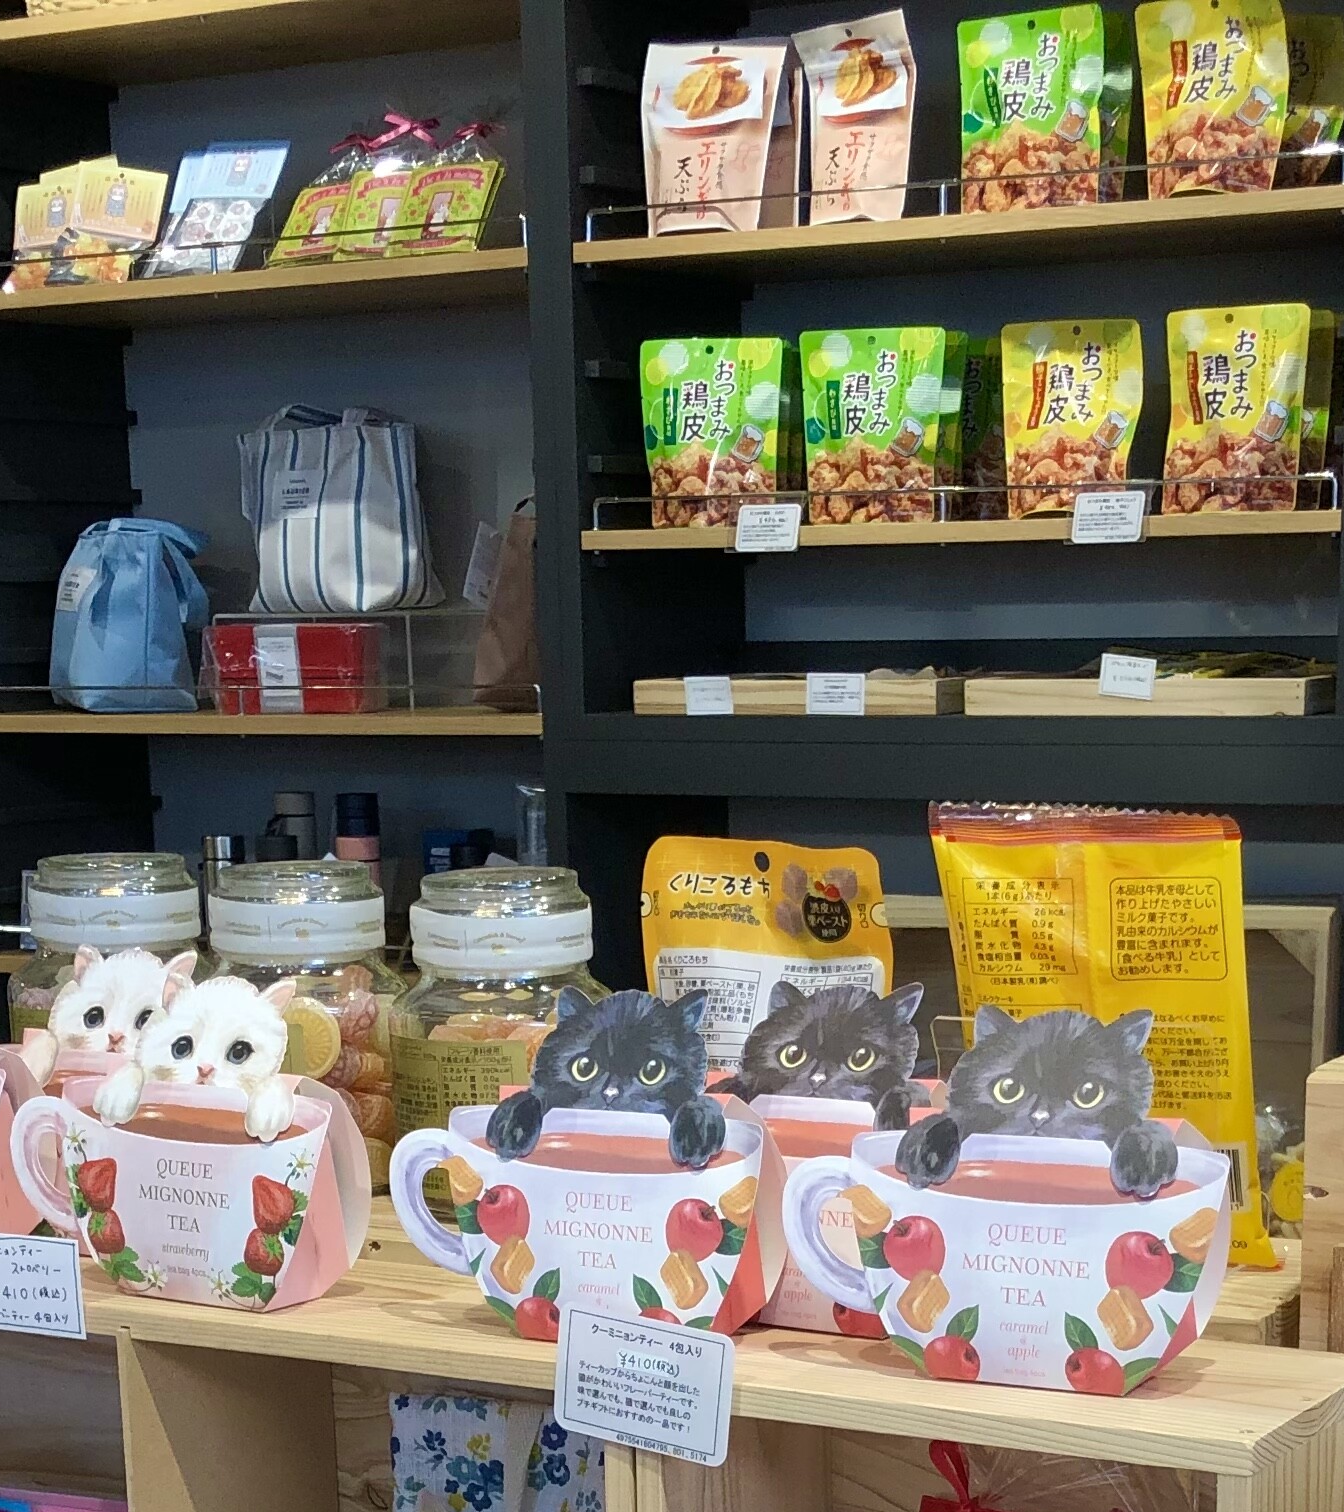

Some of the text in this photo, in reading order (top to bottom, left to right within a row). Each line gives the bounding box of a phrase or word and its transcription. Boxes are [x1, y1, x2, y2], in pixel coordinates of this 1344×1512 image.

[1214, 16, 1246, 100] おつまみ
[1030, 34, 1060, 120] おつまみ
[1188, 42, 1218, 103] 鶏皮
[1001, 59, 1030, 122] 鶏皮
[1071, 341, 1104, 424] おつまみ
[1202, 354, 1233, 421] 鶏皮
[1230, 330, 1258, 420] おつまみ
[709, 360, 737, 441] おつまみ
[842, 373, 871, 436] 鶏皮
[869, 350, 899, 436] おつまみ
[1044, 363, 1074, 425] 鶏皮
[680, 381, 710, 442] 鶏皮
[669, 873, 771, 898] くりころもち
[1115, 883, 1215, 897] 本品は牛乳を母として
[973, 907, 1018, 917] エネルギー
[1116, 898, 1217, 912] 作り上げたやさしい
[1116, 912, 1197, 925] ミルク菓子です。
[1116, 925, 1219, 938] 乳由来のカルシウムが
[1116, 938, 1209, 951] 豊富に含まれます。
[979, 963, 1023, 973] カルシウム
[157, 1158, 213, 1180] QUEUE
[139, 1184, 230, 1210] MIGNONNE
[565, 1191, 633, 1214] QUEUE
[167, 1214, 201, 1234] TEA
[543, 1219, 653, 1244] MIGNONNE
[987, 1223, 1067, 1247] QUEUE
[578, 1250, 617, 1270] TEA
[962, 1253, 1090, 1279] MIGNONNE
[577, 1281, 620, 1297] caramel
[1000, 1286, 1047, 1308] TEA
[998, 1320, 1049, 1336] caramel
[591, 1323, 703, 1359] クーミニョンティー 4包入り
[1007, 1345, 1041, 1361] apple
